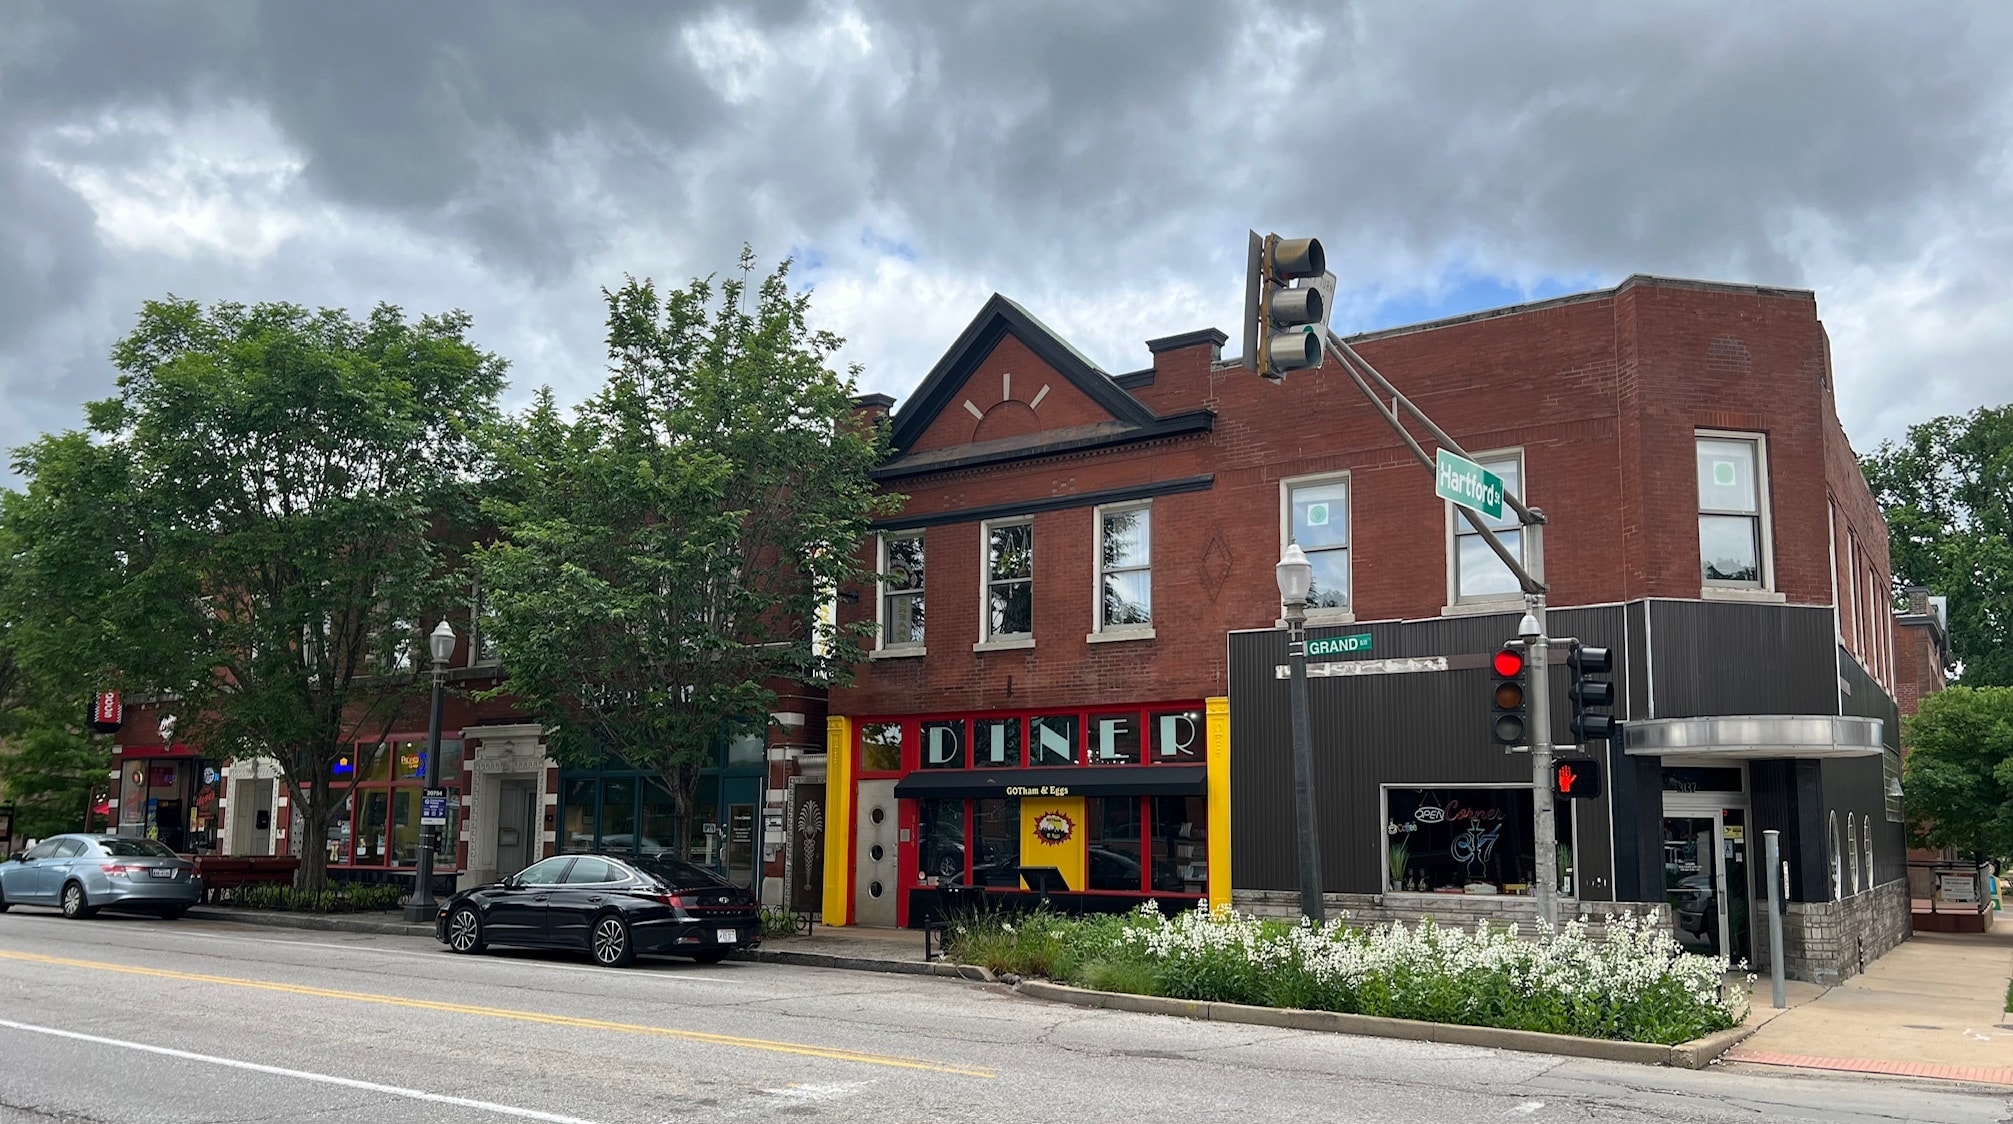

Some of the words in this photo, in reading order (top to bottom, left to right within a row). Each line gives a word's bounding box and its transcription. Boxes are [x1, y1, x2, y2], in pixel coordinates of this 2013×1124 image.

[1440, 461, 1495, 507] Hartford
[1309, 637, 1358, 655] GRAND
[928, 715, 1196, 763] DINER
[1006, 786, 1039, 796] GOTham
[1040, 785, 1049, 795] &
[1050, 785, 1069, 797] Eggs
[1415, 810, 1444, 820] OPEN
[1445, 800, 1506, 822] Corner
